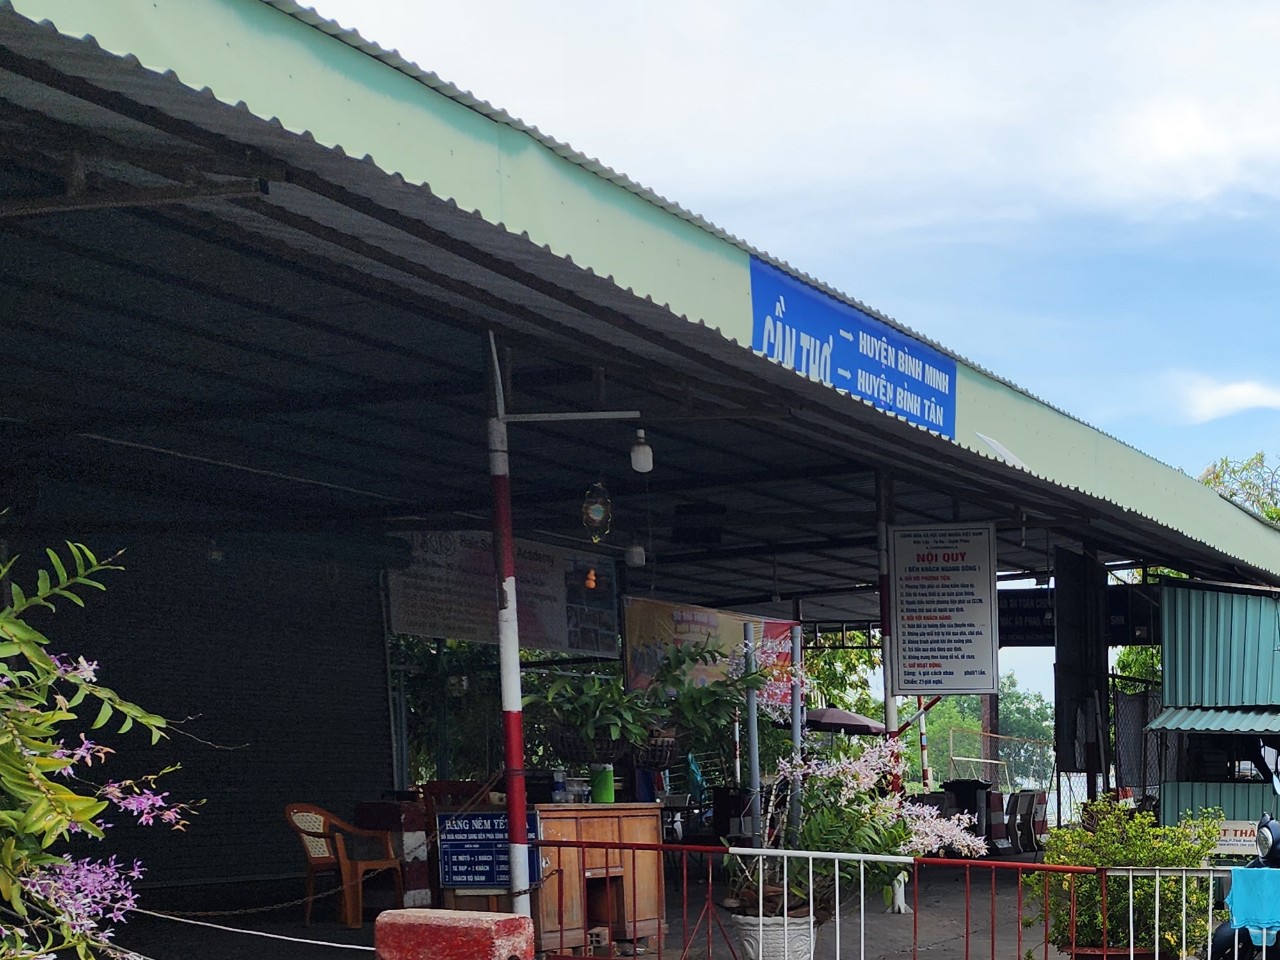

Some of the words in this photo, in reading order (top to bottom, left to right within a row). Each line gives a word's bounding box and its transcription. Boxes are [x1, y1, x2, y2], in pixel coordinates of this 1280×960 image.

[763, 295, 796, 370] CẦN
[800, 332, 833, 386] THƠ
[859, 331, 895, 369] HUYỆN
[898, 347, 923, 382] BÌNH
[924, 364, 949, 395] MINH
[857, 369, 894, 407] HUYỆN
[896, 382, 921, 418] BÌNH
[923, 397, 944, 427] TÂN
[916, 551, 938, 564] NỘI
[943, 552, 966, 563] QUY
[445, 817, 469, 829] BẢNG
